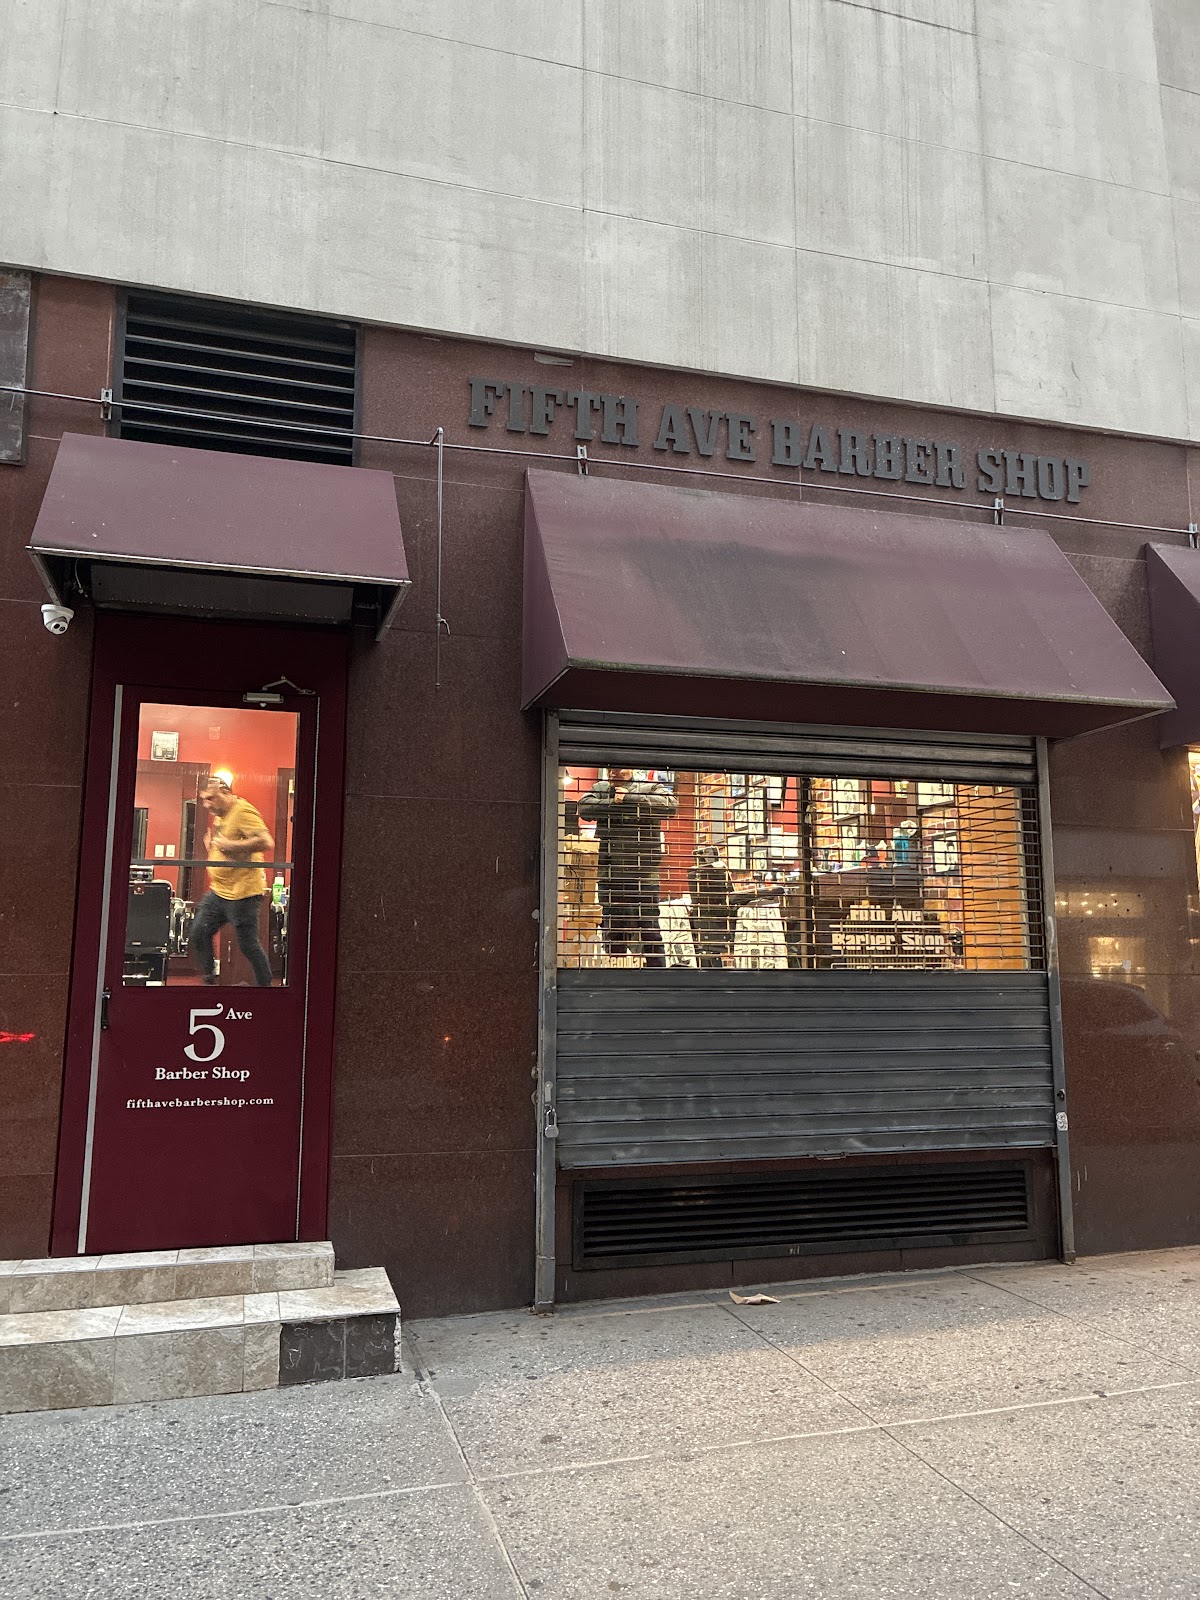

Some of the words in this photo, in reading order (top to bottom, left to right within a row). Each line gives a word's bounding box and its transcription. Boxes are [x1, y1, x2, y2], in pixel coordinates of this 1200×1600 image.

[468, 376, 639, 446] FIFTH
[653, 404, 757, 462] AVE
[771, 418, 966, 490] BARBER
[977, 447, 1091, 503] SHOP
[891, 904, 922, 922] Ave
[832, 932, 896, 951] Barber
[901, 930, 945, 954] Shop
[183, 1002, 226, 1063] 5
[225, 1007, 253, 1020] Ave
[154, 1067, 209, 1081] Barber
[211, 1066, 251, 1082] Shop
[126, 1097, 274, 1109] fifthavebarbershop.com
